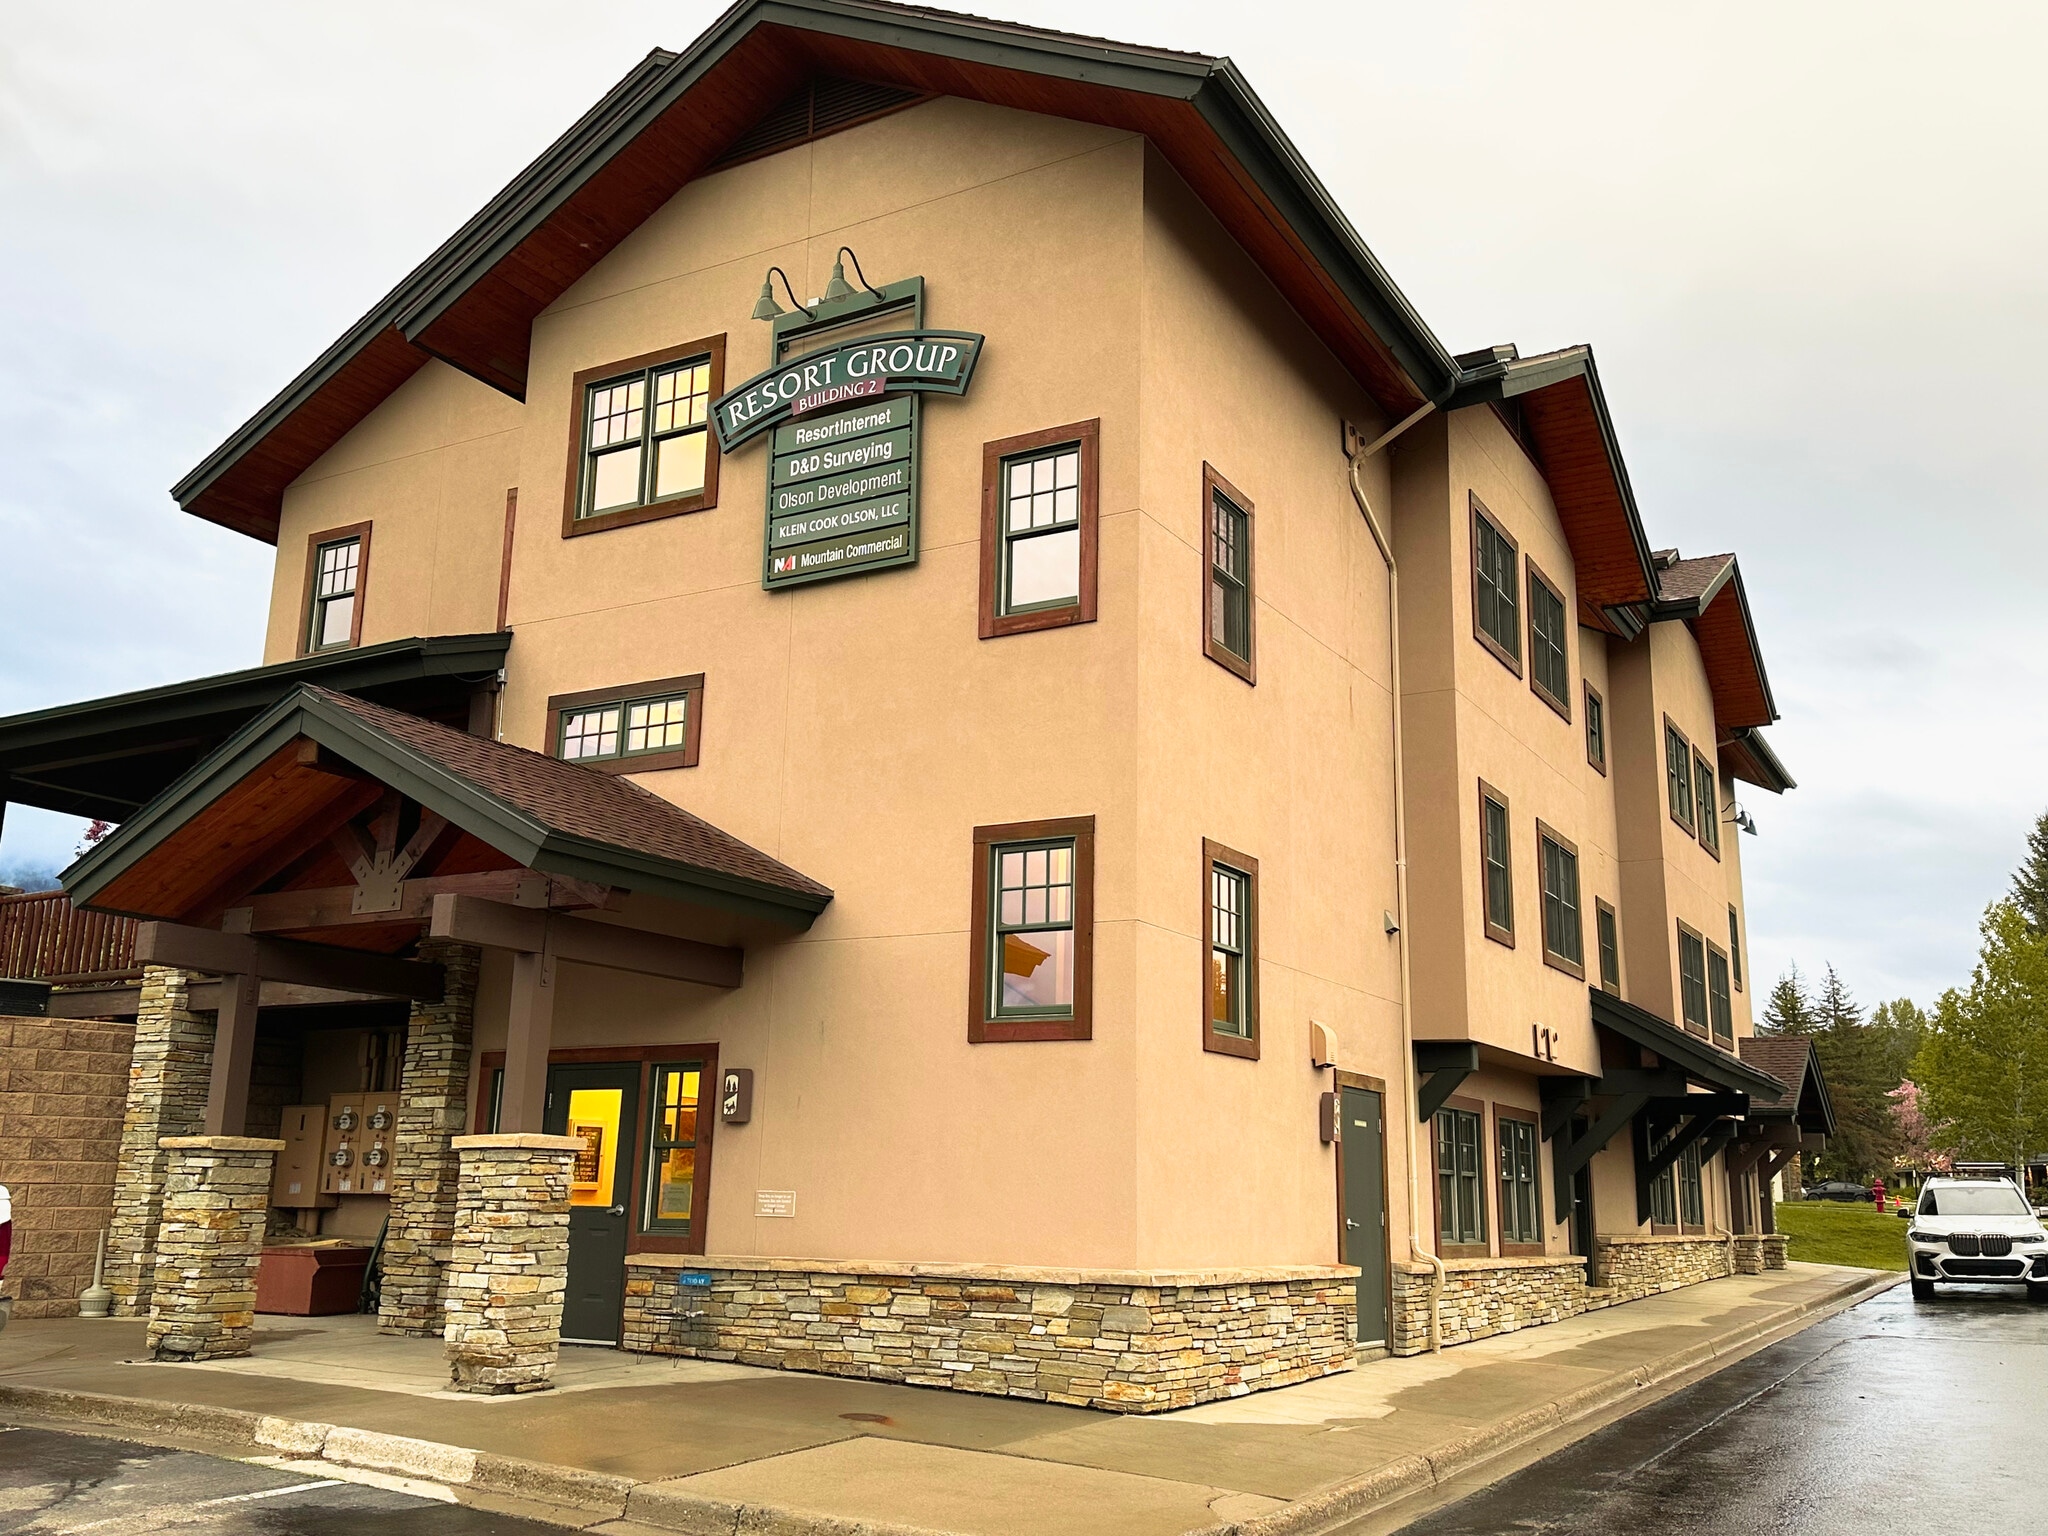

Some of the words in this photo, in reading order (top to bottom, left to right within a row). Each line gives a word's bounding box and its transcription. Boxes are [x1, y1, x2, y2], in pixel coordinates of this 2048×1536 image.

[728, 357, 837, 428] RESORT
[846, 345, 958, 378] GROUP
[799, 381, 864, 412] BUILDING
[868, 380, 877, 394] 2
[796, 408, 892, 445] ResortInternet
[790, 455, 820, 477] D&D
[823, 441, 893, 469] Surveying
[779, 490, 814, 509] Olson
[818, 468, 902, 501] Development
[779, 521, 807, 538] KLEIN
[809, 515, 839, 532] COOK
[840, 507, 879, 526] OLSON,
[881, 503, 900, 518] LLC
[774, 554, 797, 574] NAI
[800, 546, 844, 568] Mountain
[846, 534, 903, 559] Commercial
